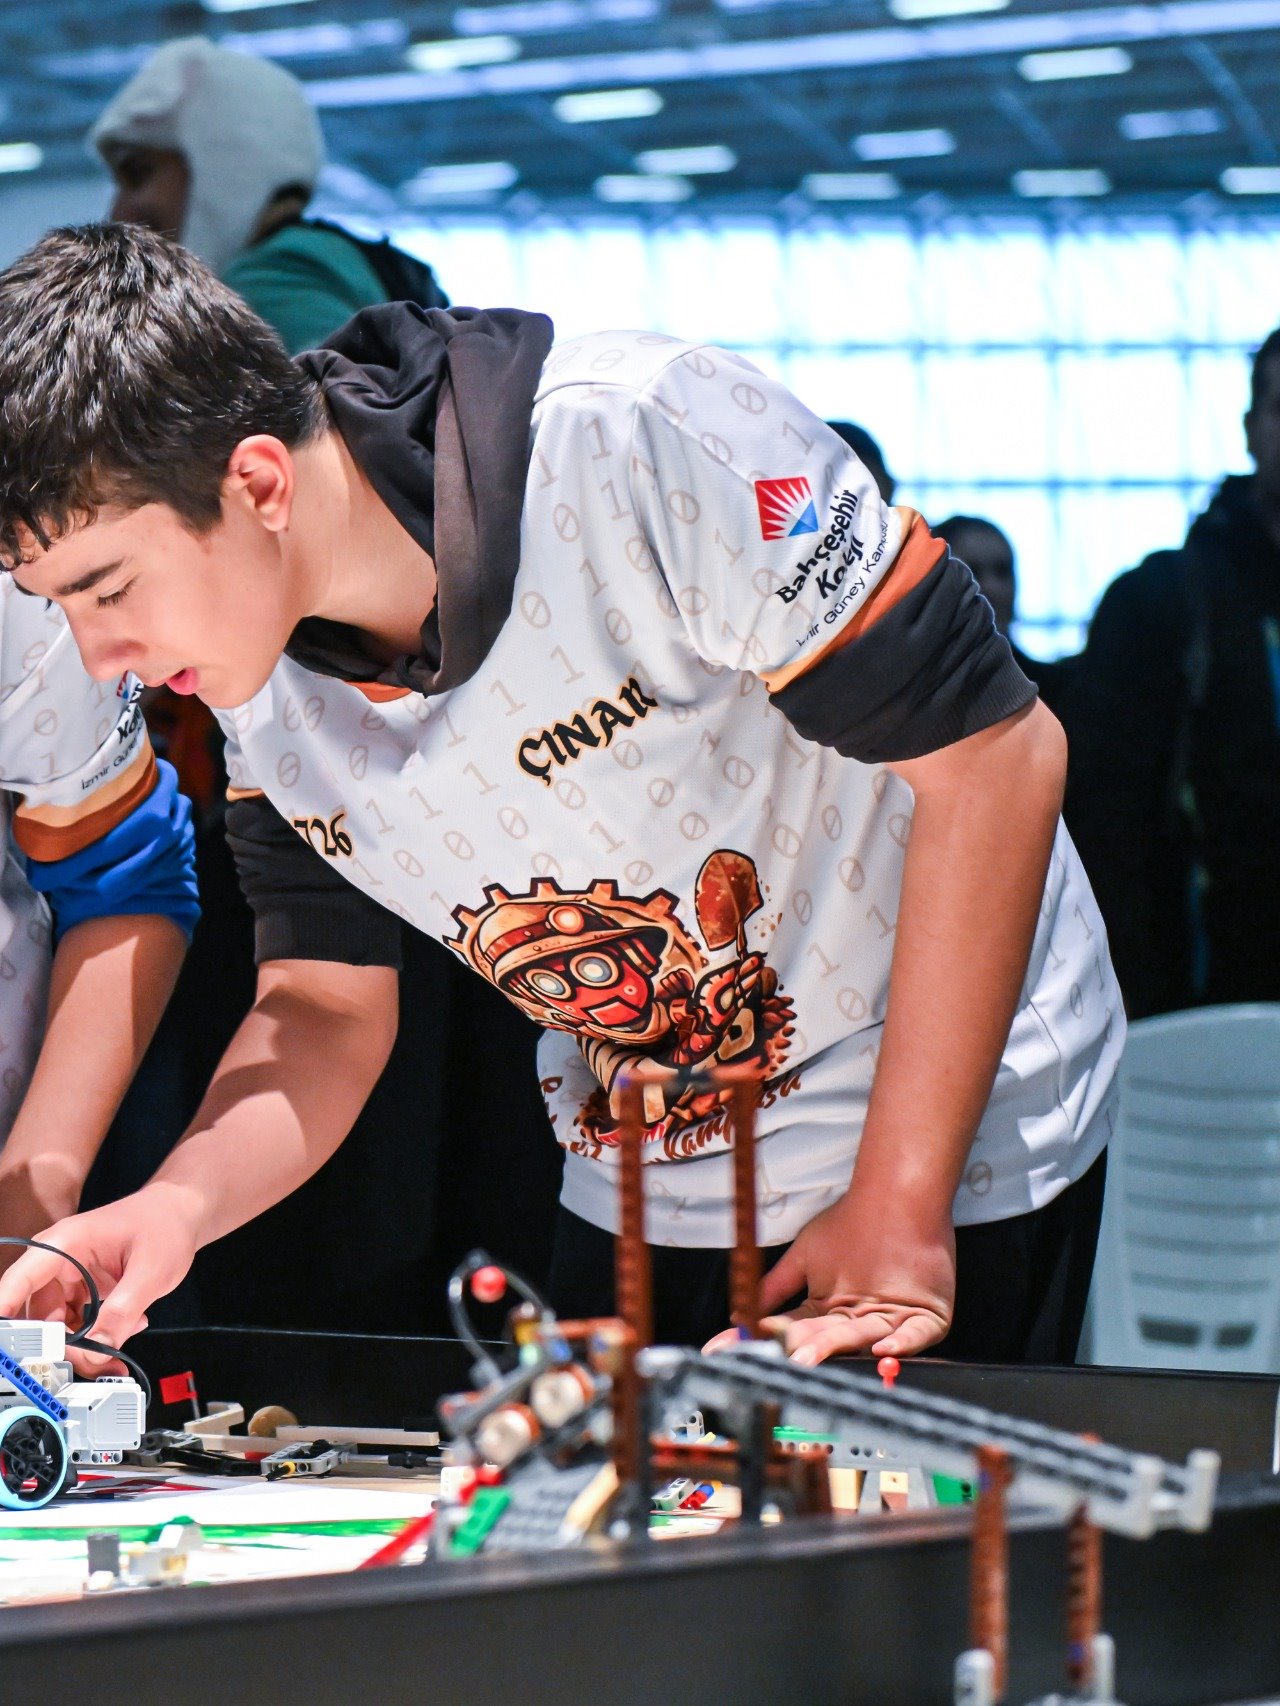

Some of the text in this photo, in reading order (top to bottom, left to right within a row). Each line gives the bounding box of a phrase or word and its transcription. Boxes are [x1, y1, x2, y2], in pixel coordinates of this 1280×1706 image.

[775, 489, 859, 604] Bahçeşehir
[824, 577, 866, 625] Güney
[518, 677, 658, 786] ÇINAR
